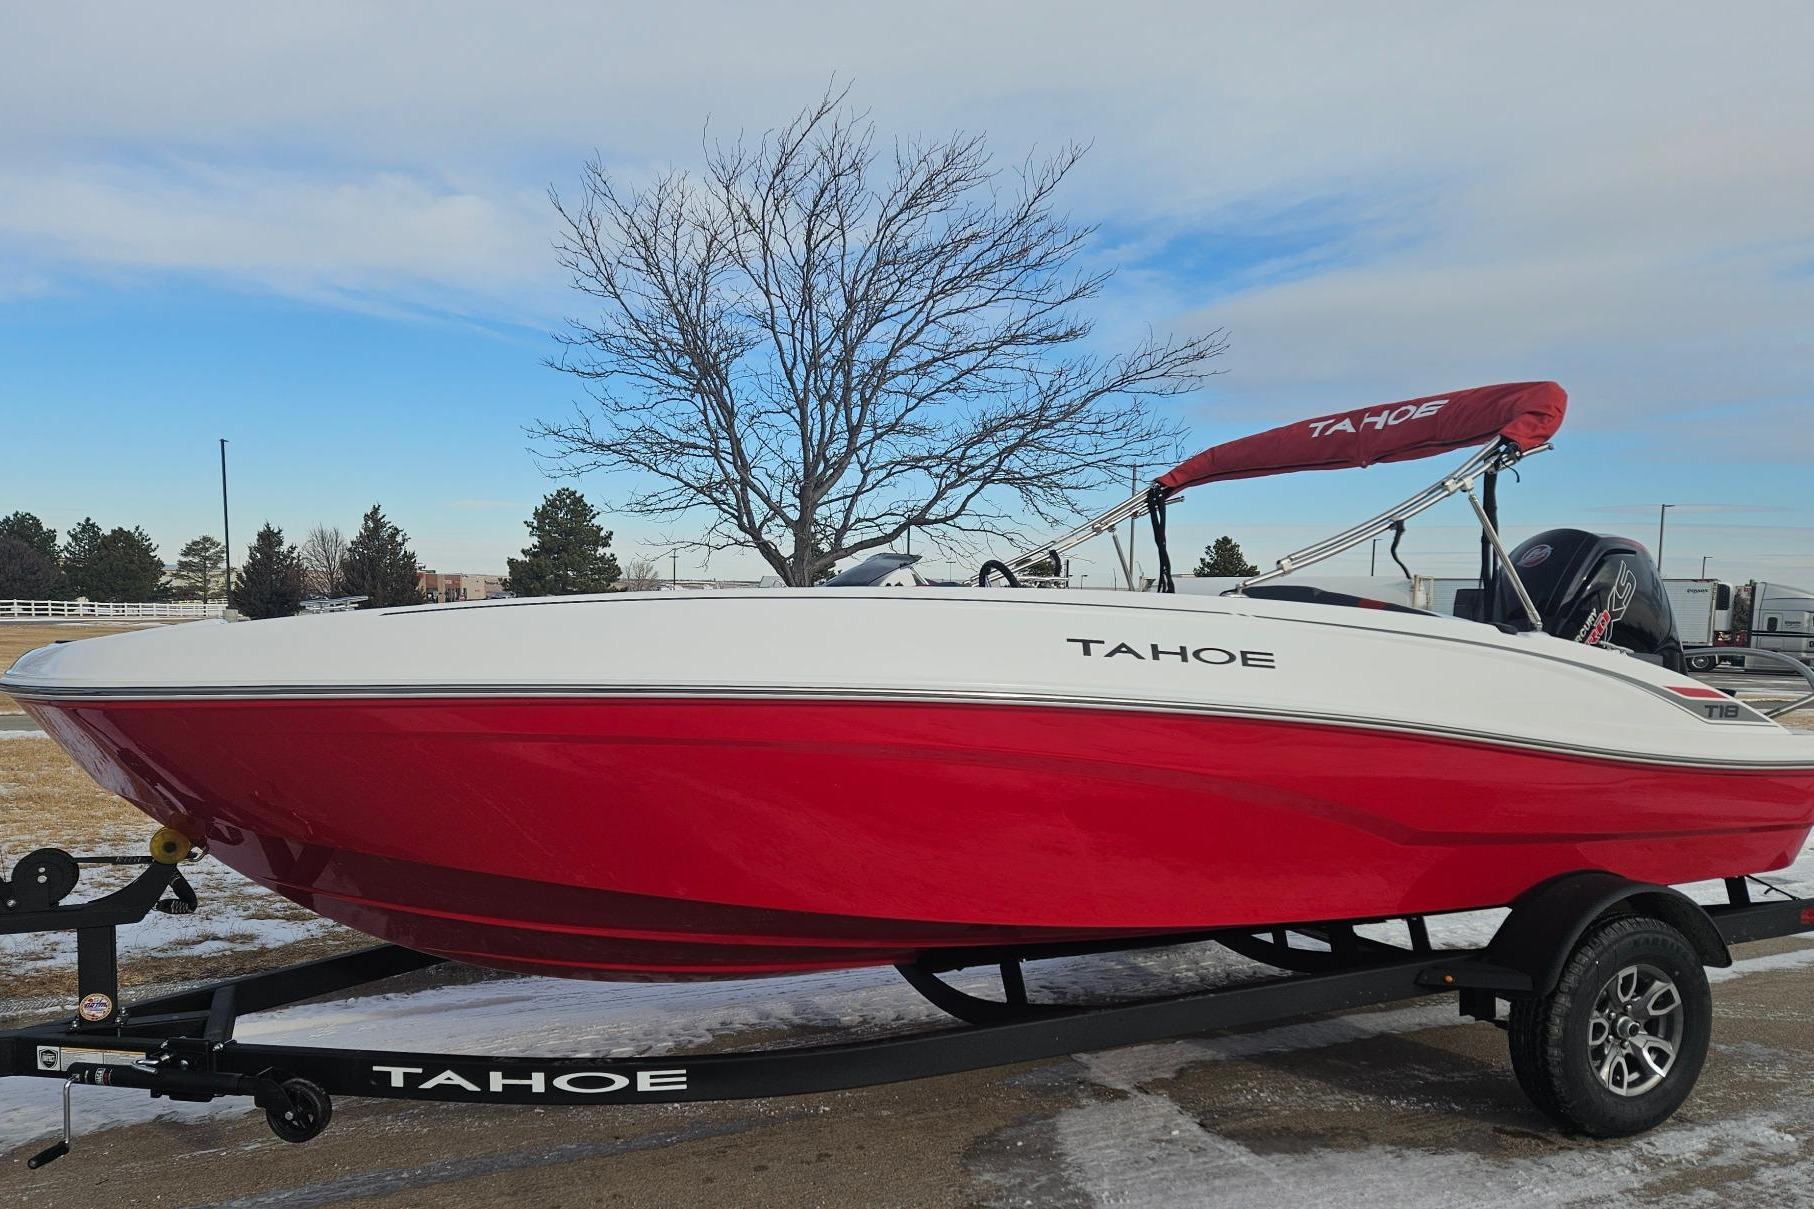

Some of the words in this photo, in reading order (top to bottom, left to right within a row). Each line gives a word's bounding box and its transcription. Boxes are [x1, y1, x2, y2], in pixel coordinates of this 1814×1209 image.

[1308, 399, 1450, 438] TAHOE
[1604, 560, 1637, 643] XS
[1066, 638, 1276, 669] TAHOE
[1704, 704, 1739, 718] T18
[372, 1065, 688, 1093] TAHOE
